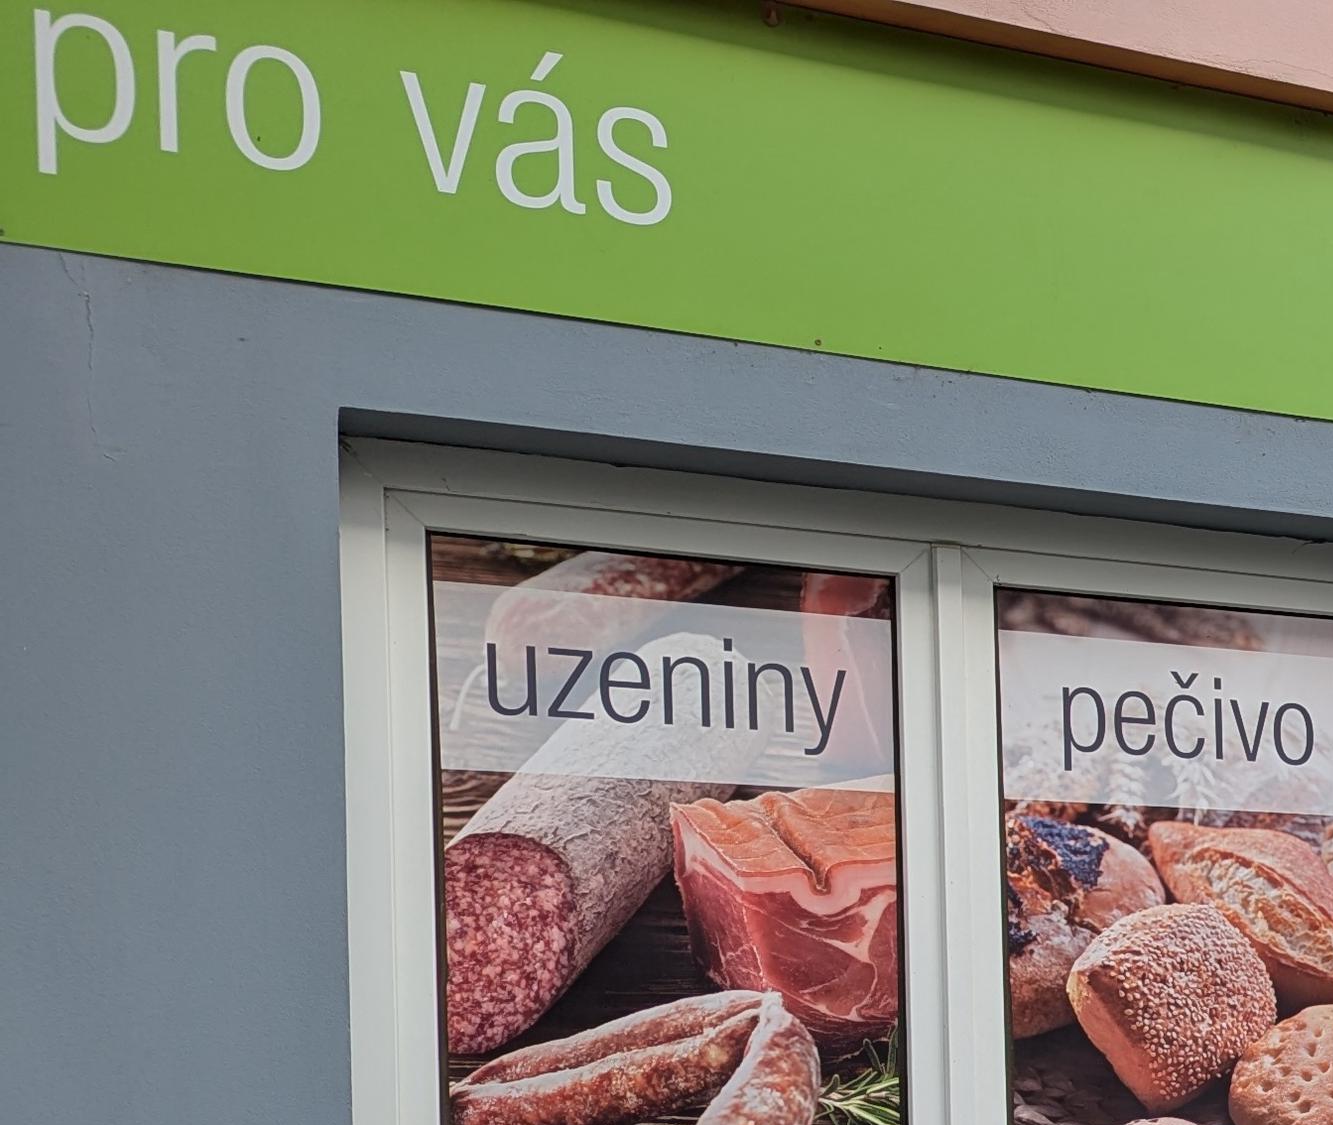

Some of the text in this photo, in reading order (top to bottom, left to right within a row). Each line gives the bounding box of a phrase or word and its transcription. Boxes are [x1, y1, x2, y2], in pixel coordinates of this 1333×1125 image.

[34, 8, 673, 227] pro vás
[485, 638, 1315, 772] uzeniny pečivo
